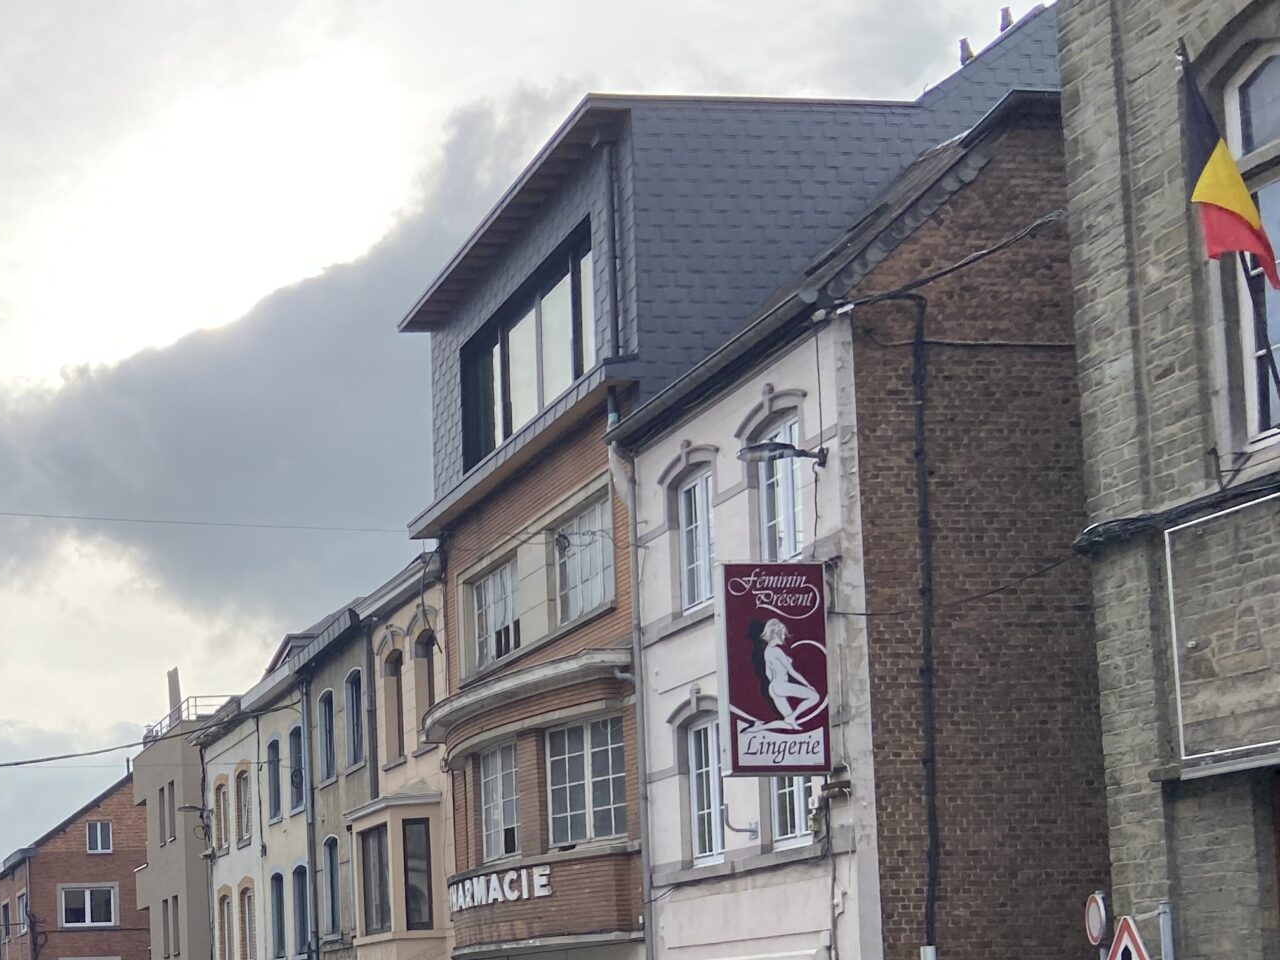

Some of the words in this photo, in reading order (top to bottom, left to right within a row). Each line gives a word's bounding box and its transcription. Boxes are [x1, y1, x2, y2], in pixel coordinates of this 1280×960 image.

[728, 568, 807, 596] Féminin
[752, 589, 813, 608] Présent
[743, 734, 821, 764] Lingerie
